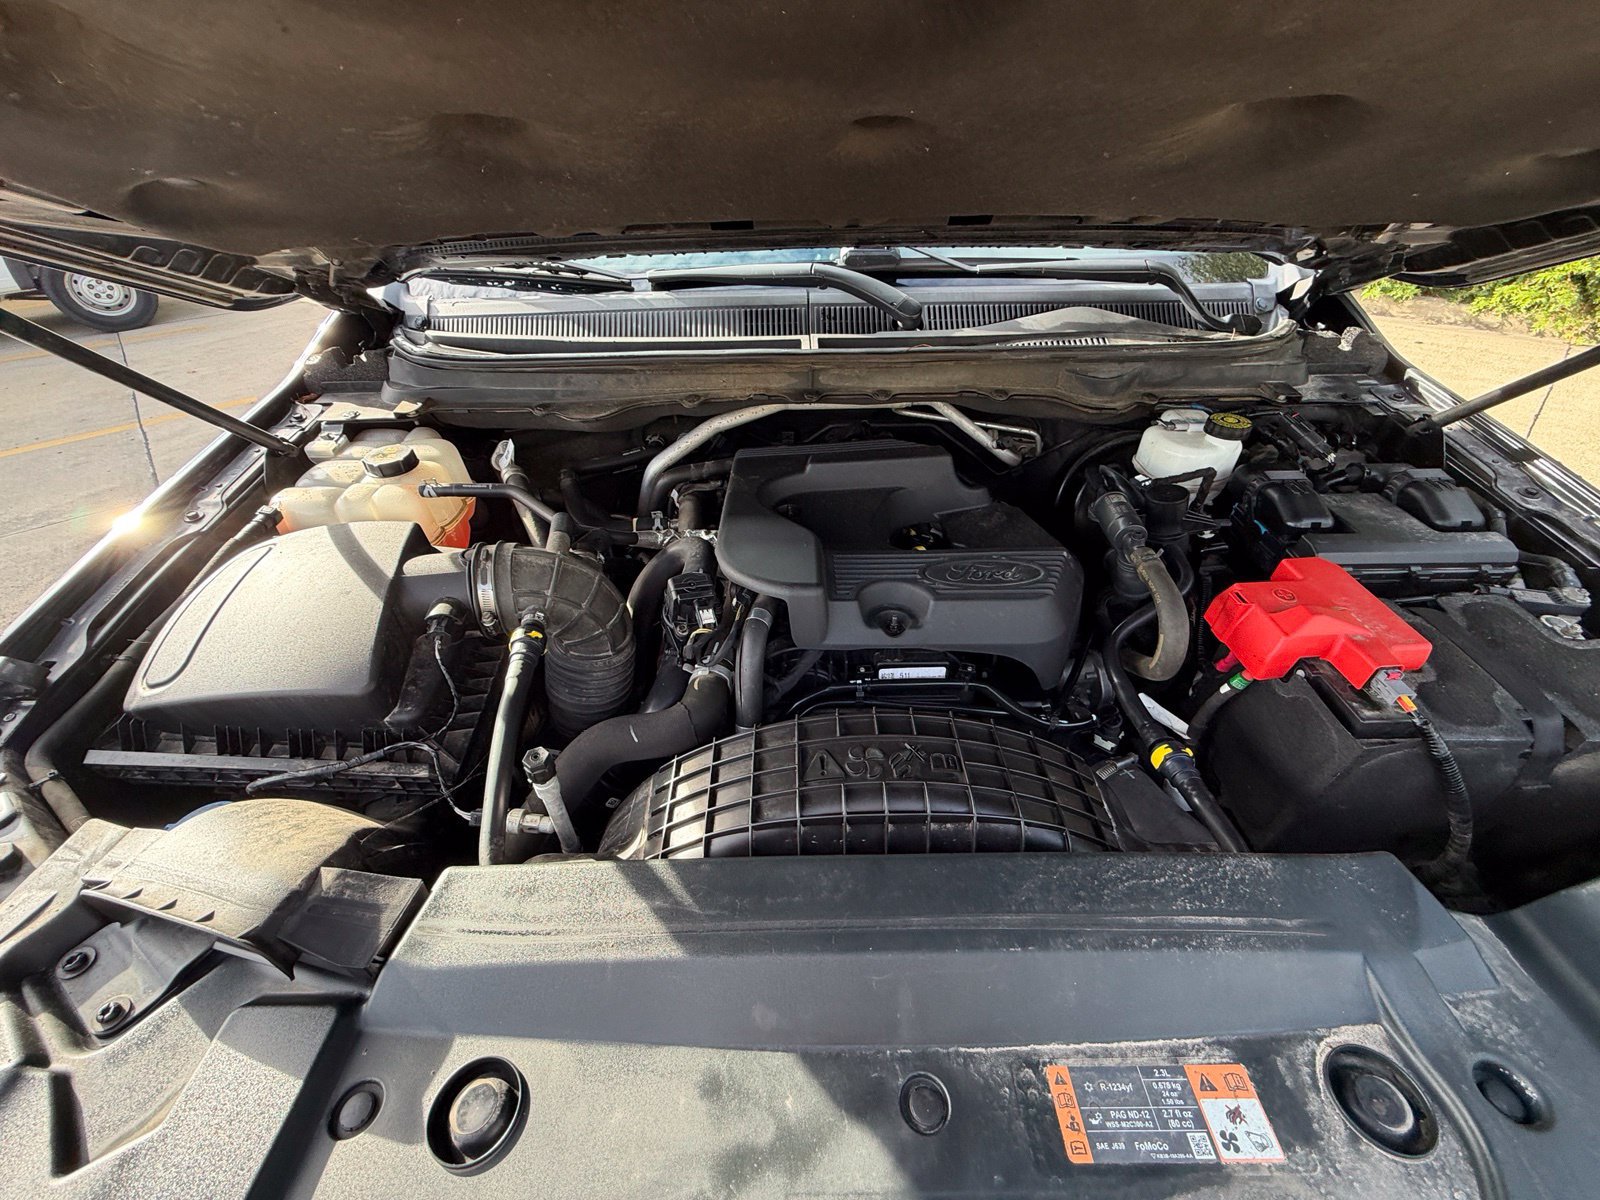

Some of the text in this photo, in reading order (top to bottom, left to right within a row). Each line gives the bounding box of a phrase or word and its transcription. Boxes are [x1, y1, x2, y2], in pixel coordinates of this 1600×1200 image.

[946, 562, 1020, 581] Ford
[1153, 1068, 1171, 1077] 2.3L
[1099, 1082, 1134, 1092] R-1234yf
[1171, 1081, 1182, 1091] kg
[1109, 1110, 1151, 1120] PAG ND-12
[1161, 1109, 1175, 1118] 2.7
[1182, 1110, 1194, 1118] oz
[1181, 1120, 1195, 1130] cc)
[1095, 1142, 1110, 1150] SAE
[1134, 1141, 1169, 1151] FoMoCo
